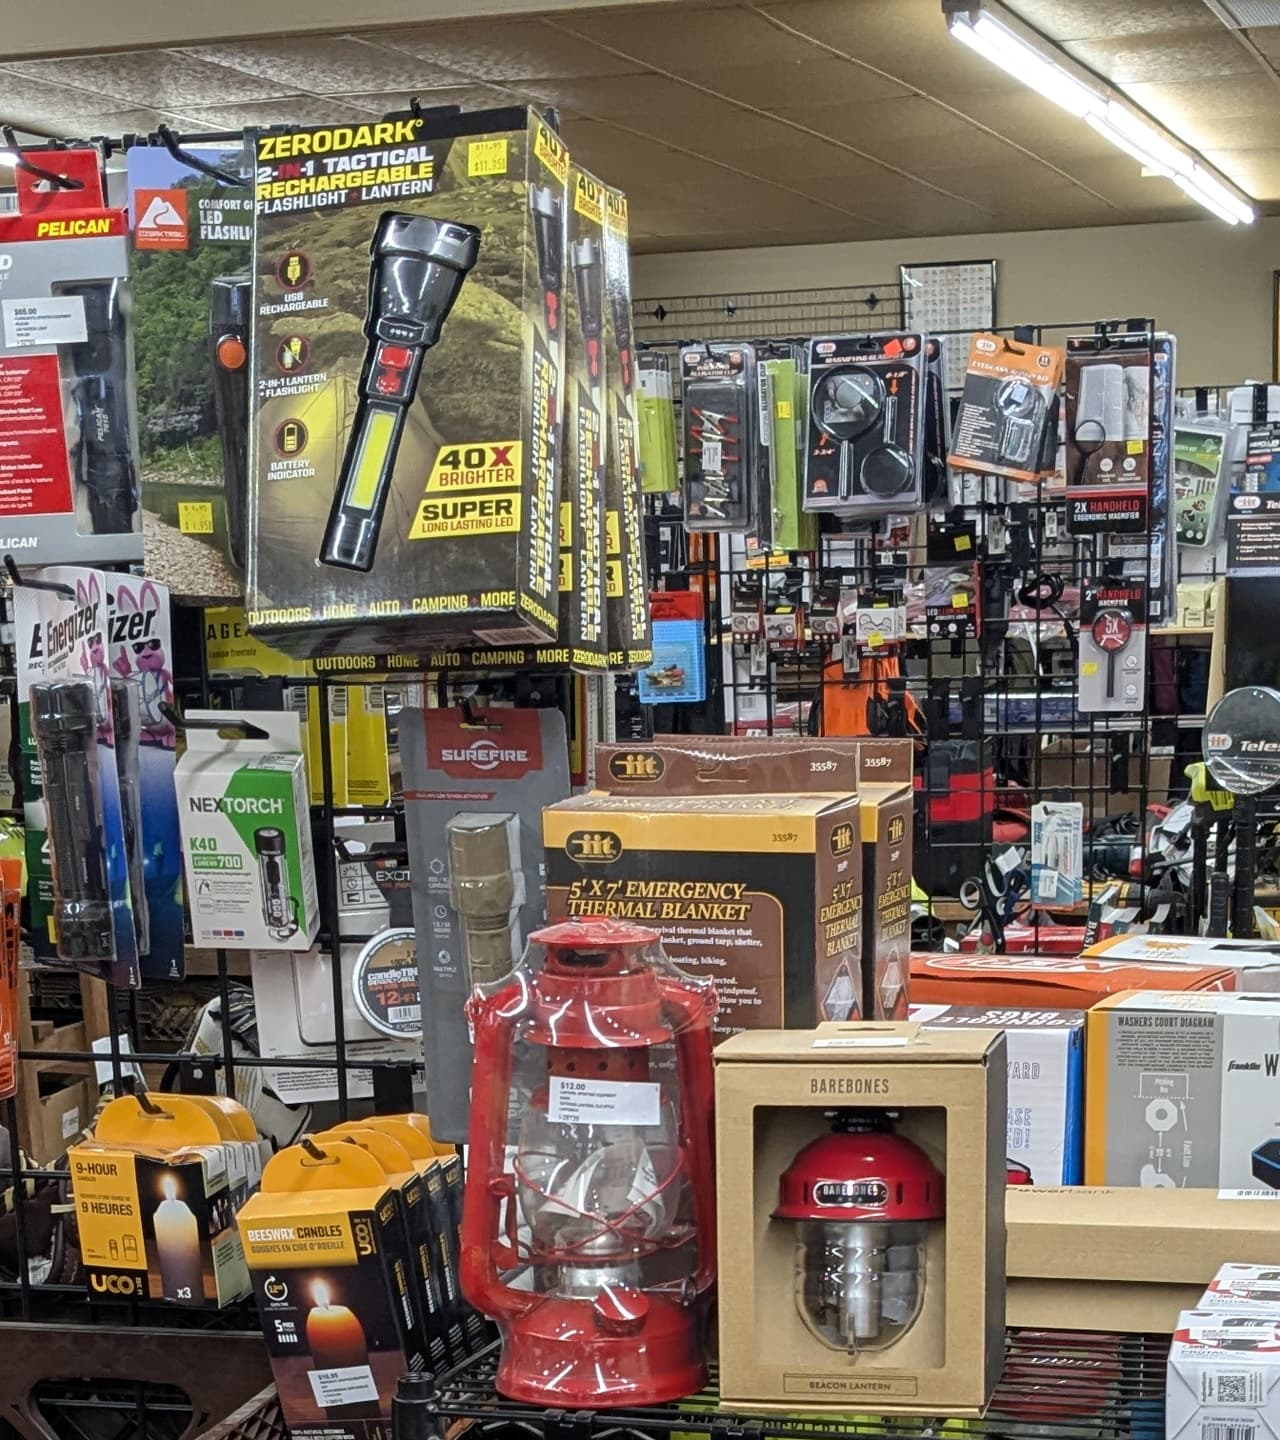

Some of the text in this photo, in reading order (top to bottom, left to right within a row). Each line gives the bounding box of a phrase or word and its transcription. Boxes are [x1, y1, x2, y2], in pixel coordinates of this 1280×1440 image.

[258, 119, 416, 161] ZERODARK
[258, 146, 434, 183] 2-IN-1 TACTICAL
[257, 162, 434, 200] RECHARGEABLE
[257, 179, 433, 216] FLASHLIGHT LANTERN
[37, 220, 110, 238] PELICAN
[284, 293, 304, 302] USB
[259, 298, 329, 316] RECHARGEABLE
[270, 461, 312, 473] BATTERY
[439, 445, 515, 471] 40X
[267, 469, 315, 481] INDICATOR
[439, 468, 515, 486] BRIGHTER
[422, 498, 514, 522] SUPER
[422, 517, 514, 533] LONG LASTING LED
[247, 590, 516, 625] OUTDOORS HOME AUTO CAMPING MORE
[46, 600, 100, 653] Energizer
[316, 649, 570, 670] OUTDOORS HOME AUTO CAMPING MORE
[441, 750, 529, 762] SUREFIRE
[809, 760, 838, 773] 35587
[189, 796, 284, 814] NEXTORCH
[189, 836, 217, 851] K40
[589, 880, 604, 896] X
[624, 881, 747, 900] EMERGENCY
[567, 899, 751, 921] THERMAL BLANKET
[560, 1081, 586, 1091] $12.00
[809, 1079, 890, 1095] BAREBONES
[76, 1161, 119, 1177] 9-HOUR
[91, 1203, 133, 1217] HEURES
[247, 1225, 342, 1242] BEESWAX CANDLES
[90, 1273, 135, 1295] UCO
[177, 1286, 192, 1300] x3
